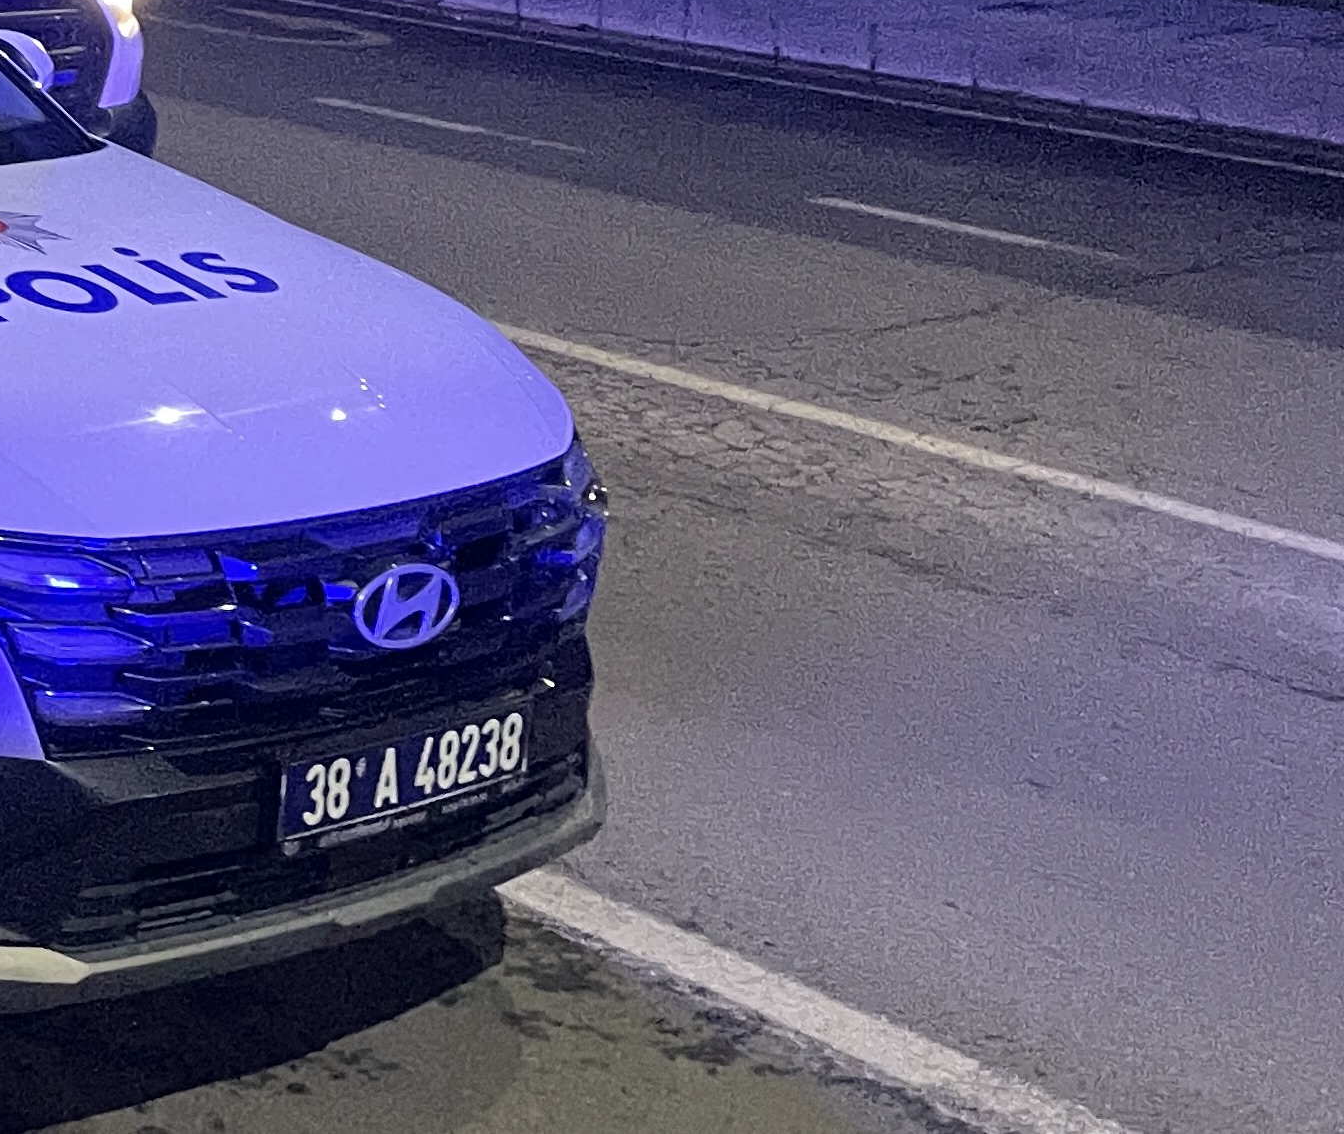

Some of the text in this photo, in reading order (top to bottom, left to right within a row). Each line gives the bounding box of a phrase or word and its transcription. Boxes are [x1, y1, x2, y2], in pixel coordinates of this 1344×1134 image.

[302, 712, 524, 826] 38 A 48238
